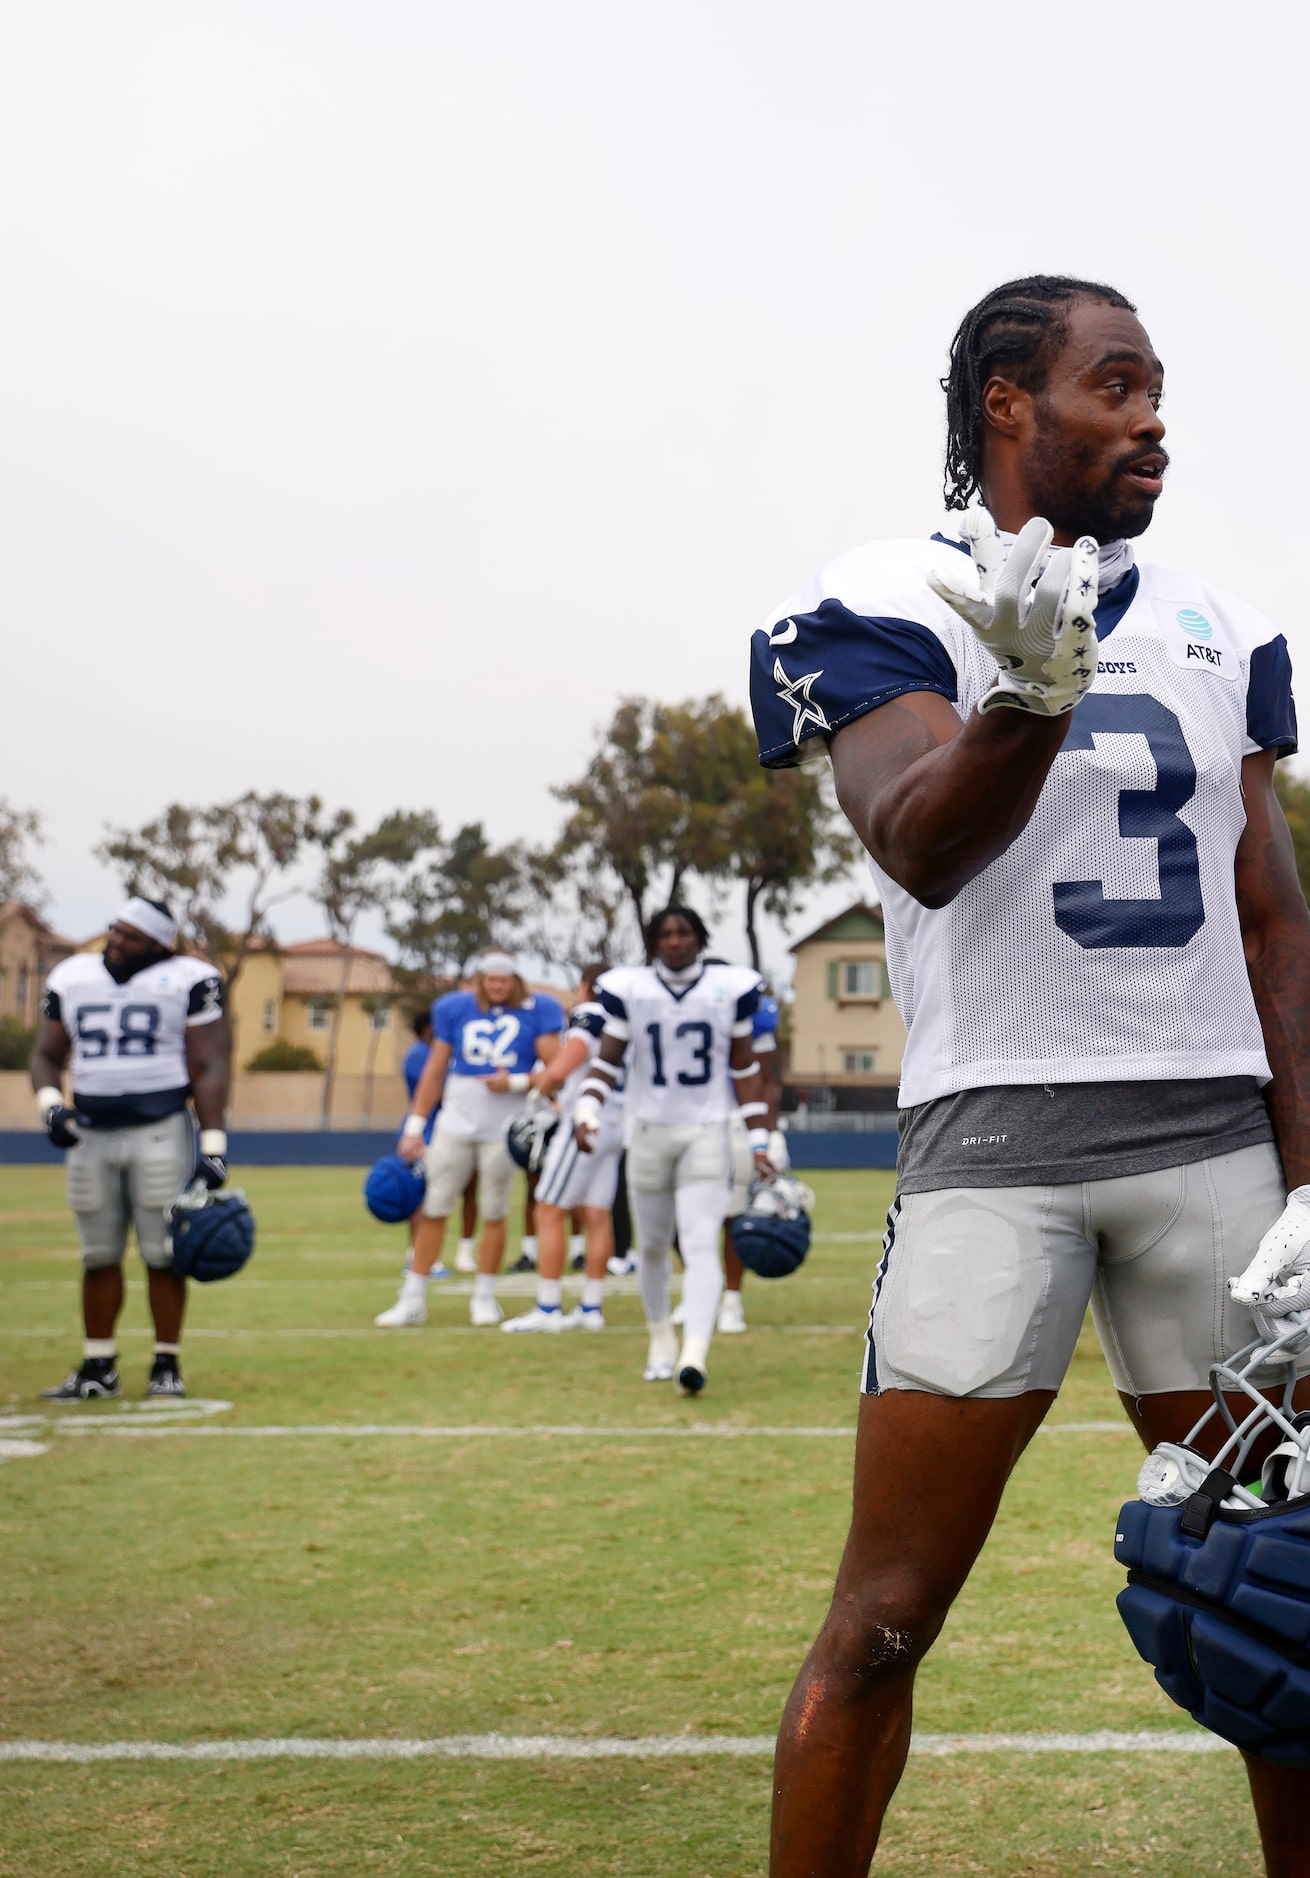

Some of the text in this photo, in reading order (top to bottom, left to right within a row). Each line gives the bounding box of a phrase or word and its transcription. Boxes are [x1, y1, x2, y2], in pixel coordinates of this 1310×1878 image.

[1186, 643, 1222, 667] AT&T
[1054, 692, 1206, 949] 3
[77, 1004, 160, 1058] 58
[462, 1013, 521, 1068] 62
[646, 1022, 712, 1085] 13
[961, 1134, 1008, 1146] DRI-FIT
